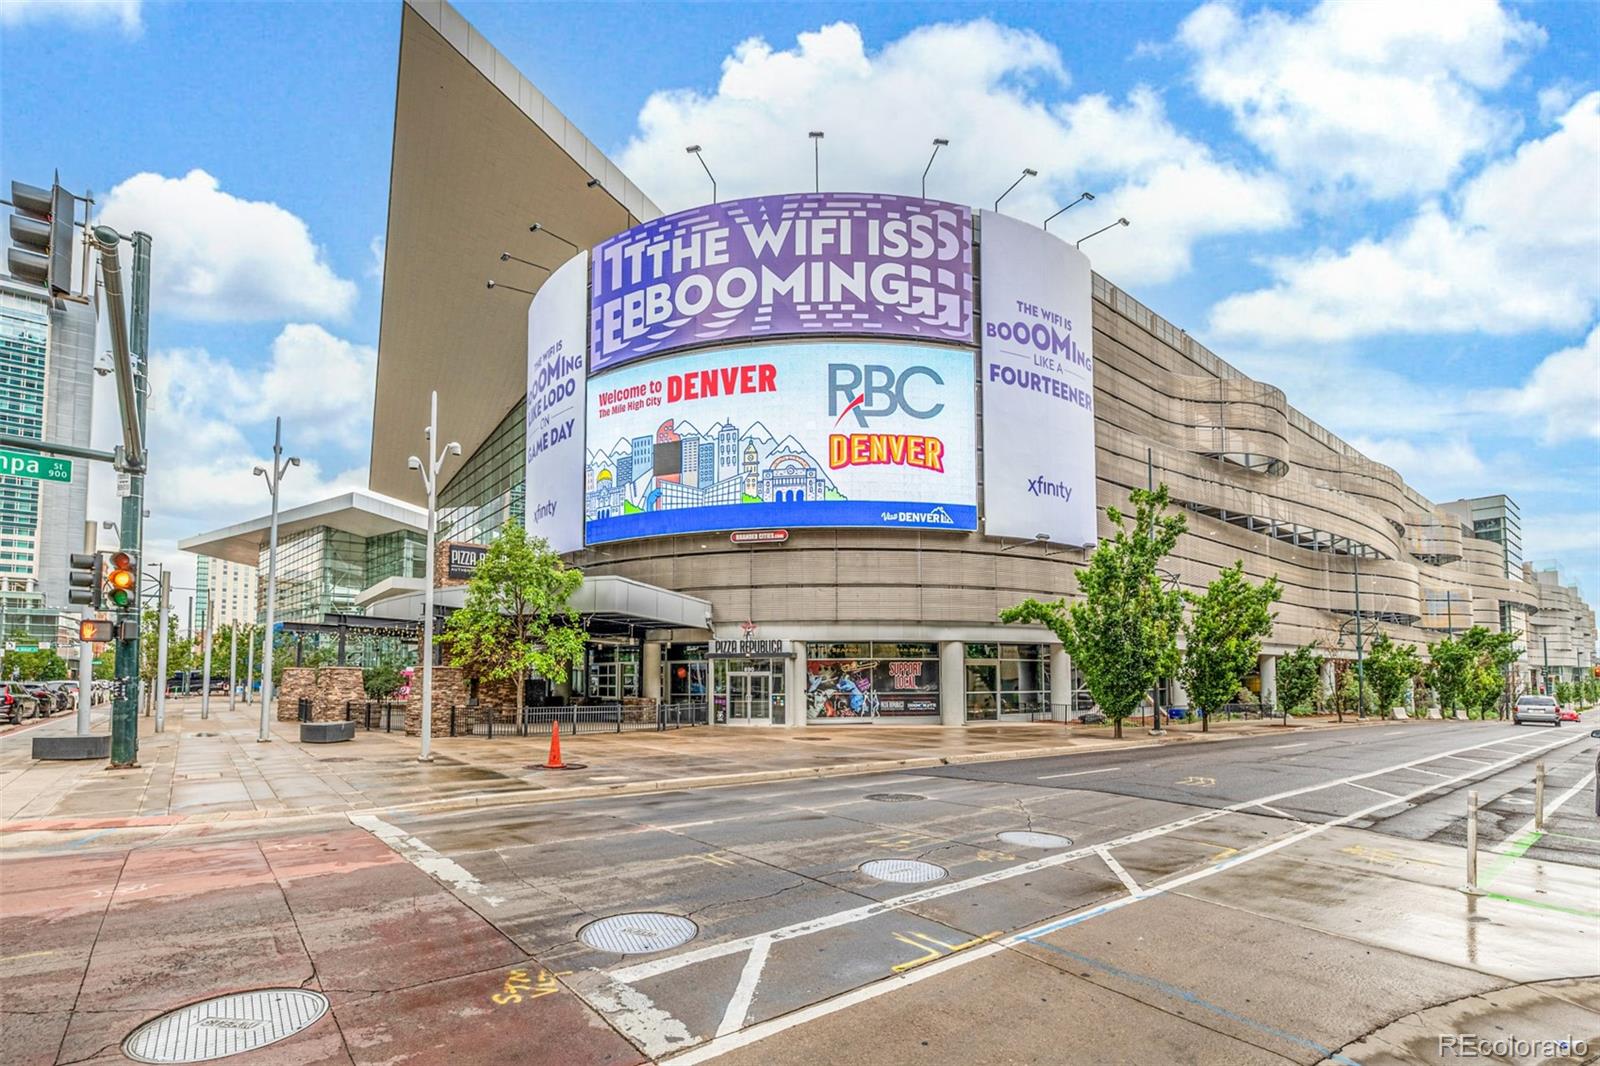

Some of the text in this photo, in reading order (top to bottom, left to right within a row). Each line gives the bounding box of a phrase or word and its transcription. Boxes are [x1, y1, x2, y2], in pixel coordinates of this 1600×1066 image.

[742, 218, 852, 259] WIFI
[1016, 300, 1073, 332] THE WIFI IS
[556, 339, 564, 353] IS
[986, 321, 1092, 372] BOOOMING
[1034, 354, 1064, 375] LIKE A
[598, 379, 663, 407] Welcome to
[667, 364, 777, 404] DENVER
[828, 363, 945, 429] RBC
[989, 363, 1093, 412] FOURTEENER
[527, 377, 576, 428] LIKE LODO
[599, 396, 662, 419] The Mile High City
[527, 417, 575, 465] GAME DAY
[829, 433, 945, 474] DENVER
[48, 469, 68, 479] 900
[53, 462, 64, 471] St
[1027, 474, 1072, 503] xfinity
[534, 499, 557, 524] xfinity
[898, 511, 940, 524] DENVER
[451, 549, 477, 566] PIZZA
[714, 639, 783, 653] PIZZA REPUBLICA
[888, 661, 923, 677] SUPPORT
[894, 675, 918, 690] LOCAL
